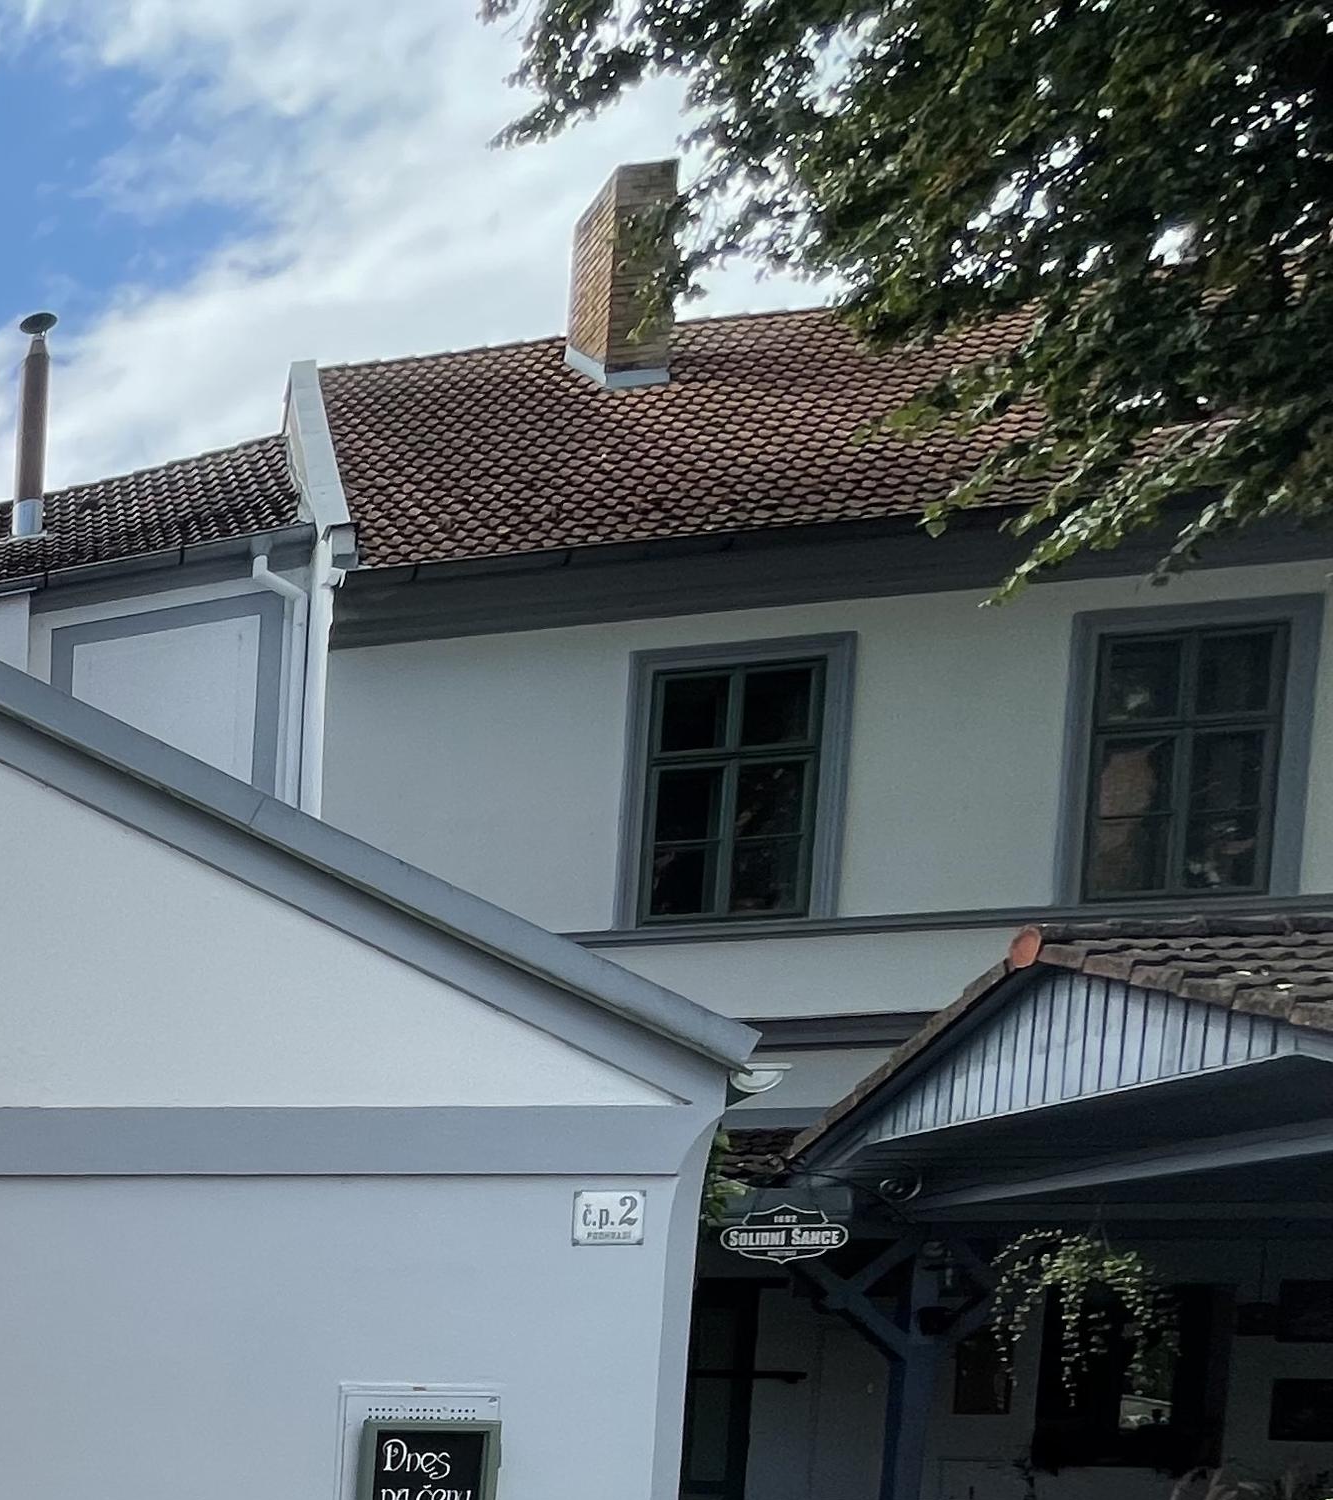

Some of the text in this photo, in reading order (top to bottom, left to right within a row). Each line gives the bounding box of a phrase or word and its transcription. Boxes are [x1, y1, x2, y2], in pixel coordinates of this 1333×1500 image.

[582, 1196, 638, 1229] č.p. 2
[729, 1226, 841, 1246] SOLIDNÍ ŠANCE
[383, 1439, 451, 1480] Dnes
